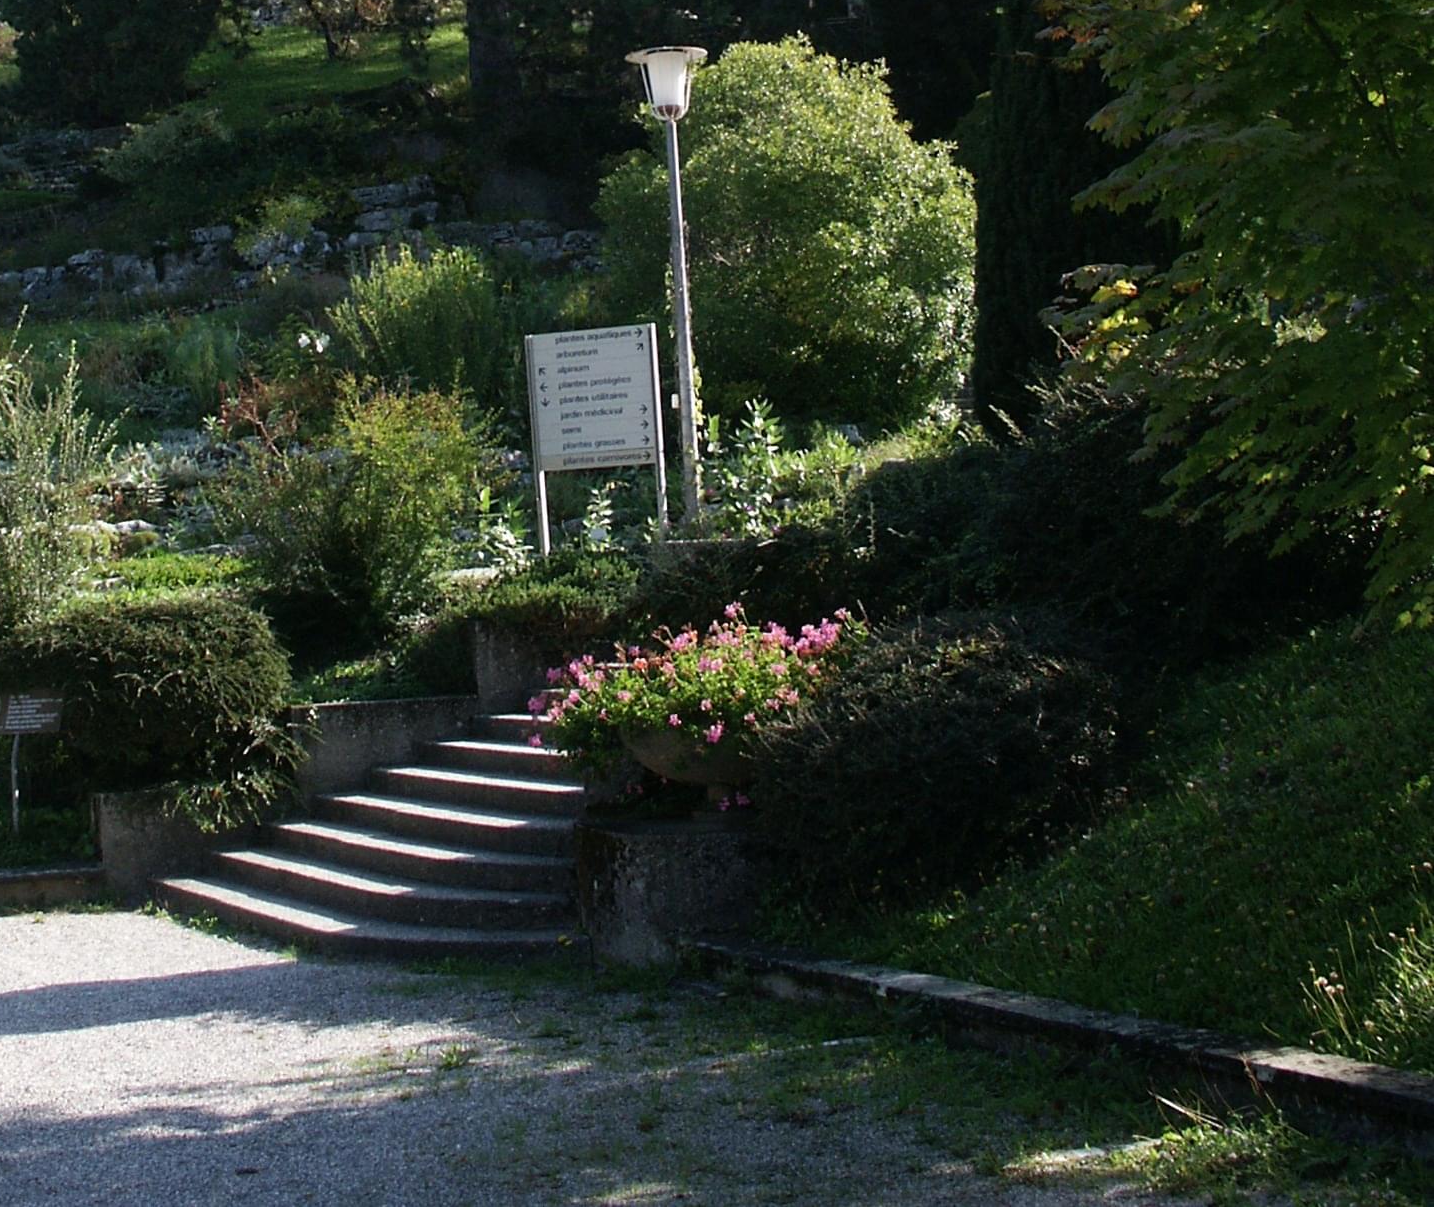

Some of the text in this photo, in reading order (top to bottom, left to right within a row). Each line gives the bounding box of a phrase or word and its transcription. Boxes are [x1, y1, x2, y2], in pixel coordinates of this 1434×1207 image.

[555, 330, 632, 345] plantes aquatiques
[556, 348, 598, 359] arboretum
[558, 380, 588, 390] plantes
[559, 395, 589, 405] plantes
[560, 410, 583, 420] jardin
[563, 441, 592, 451] plantes
[563, 456, 595, 466] plantes
